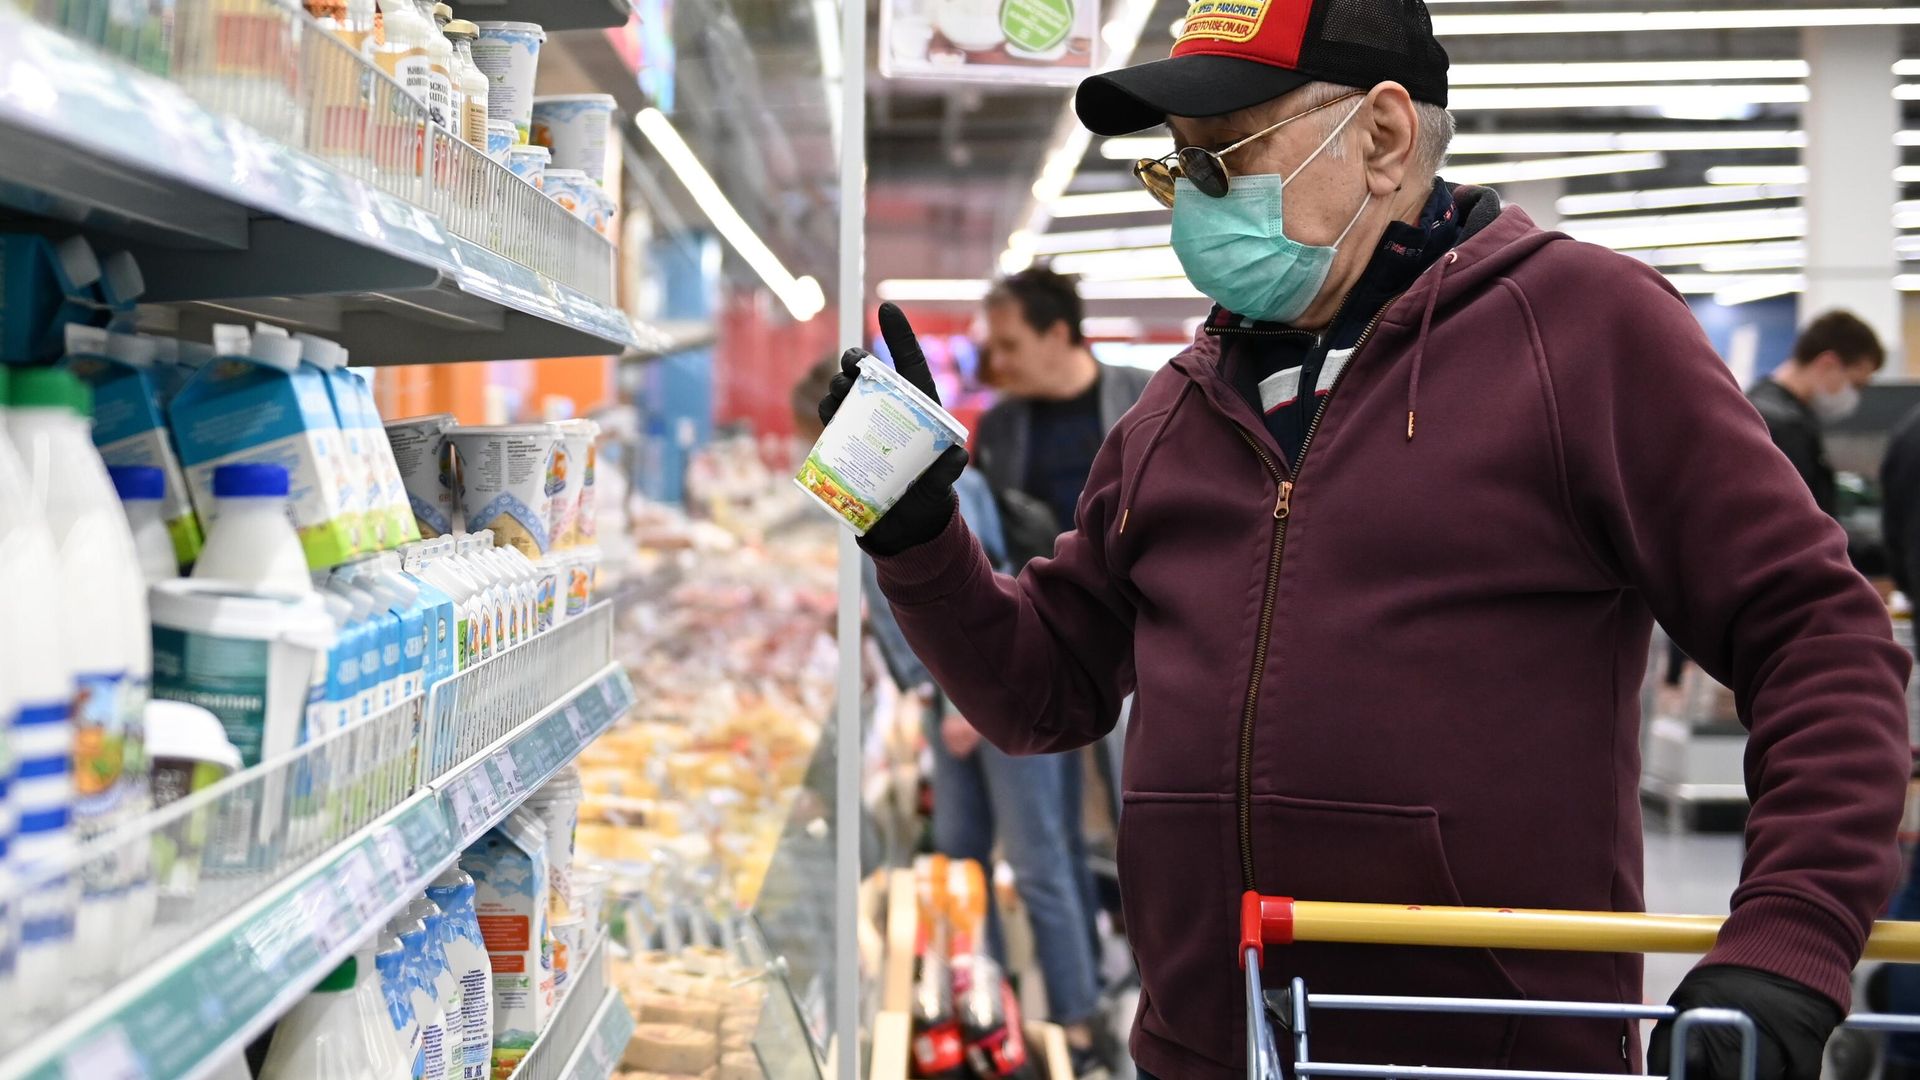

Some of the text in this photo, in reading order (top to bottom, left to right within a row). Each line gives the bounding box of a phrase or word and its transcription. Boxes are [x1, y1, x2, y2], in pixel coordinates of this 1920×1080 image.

[1216, 2, 1259, 17] PARACHUTE
[1208, 20, 1223, 31] USE
[1222, 21, 1234, 33] ON
[1233, 23, 1250, 35] AIR
